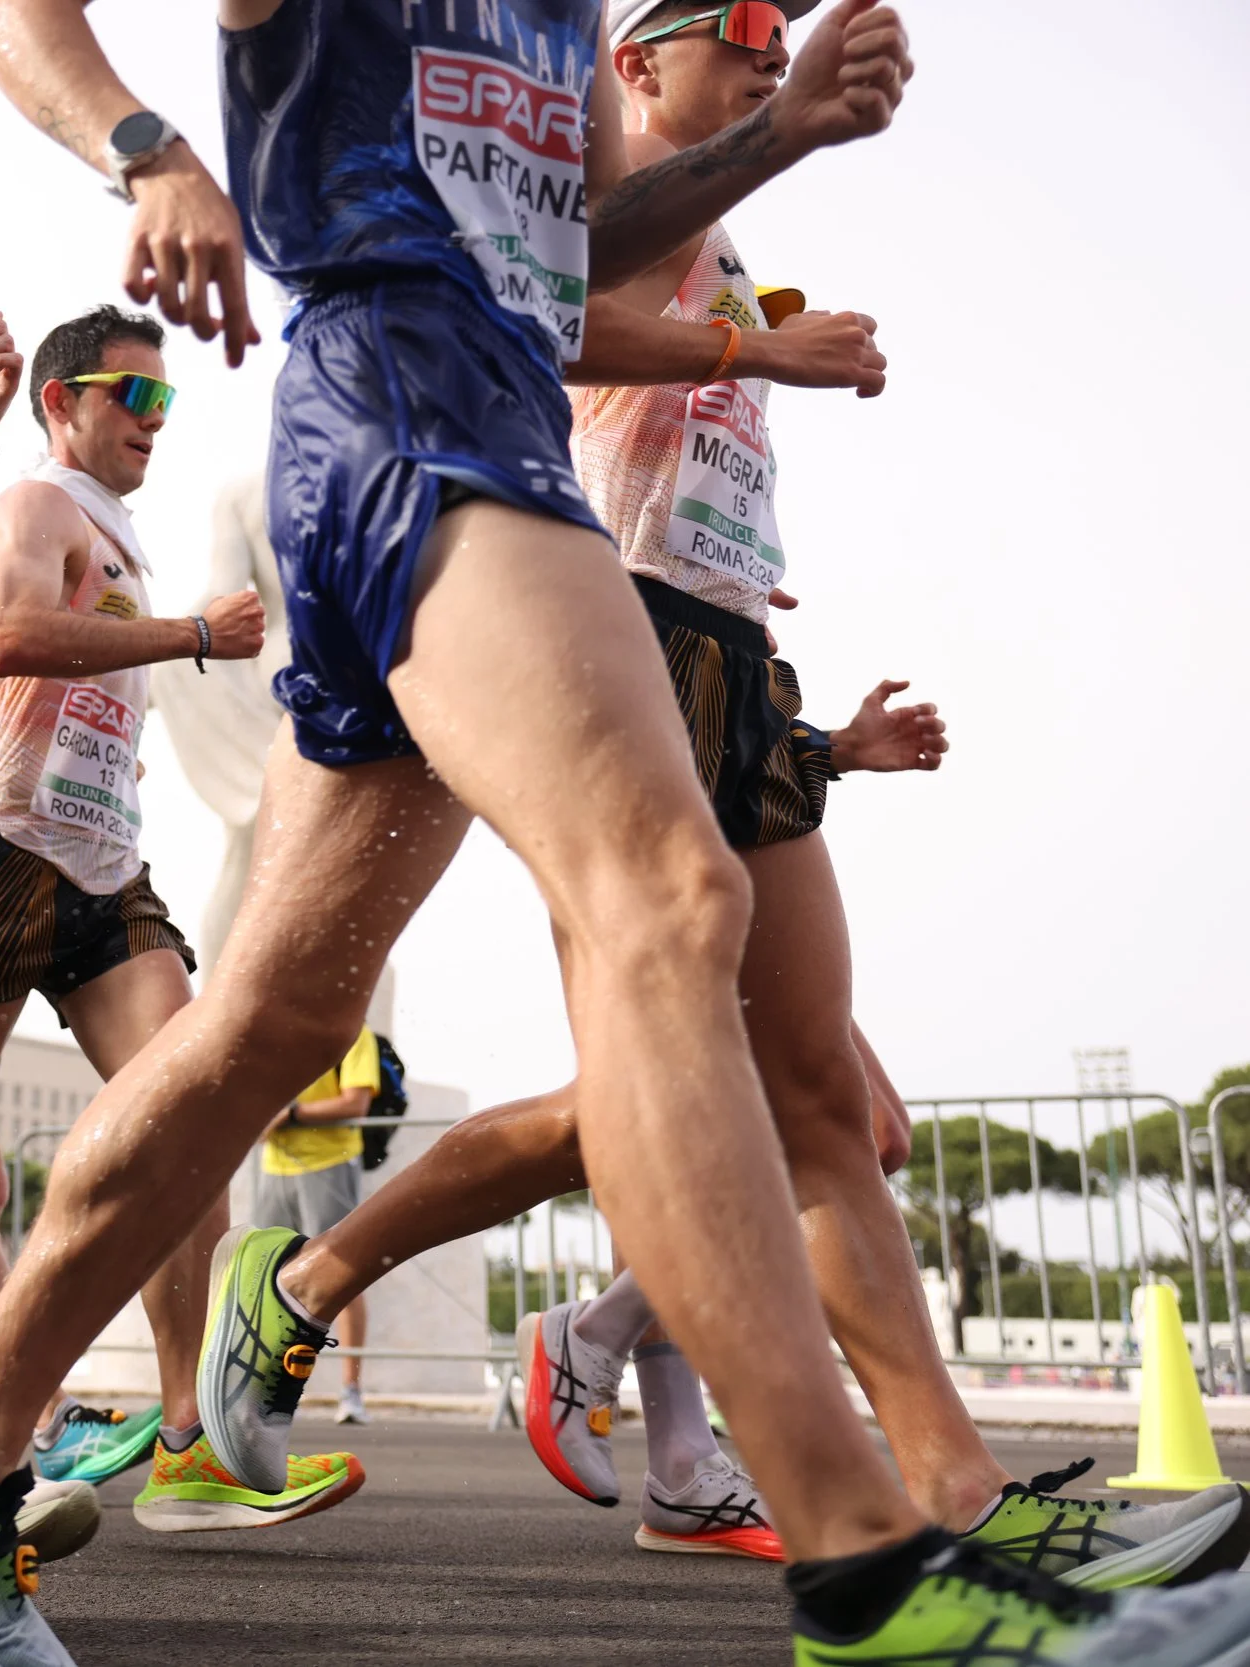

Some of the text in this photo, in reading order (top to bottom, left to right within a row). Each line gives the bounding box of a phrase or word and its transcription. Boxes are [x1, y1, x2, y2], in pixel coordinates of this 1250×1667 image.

[424, 65, 582, 154] SPAR
[422, 132, 588, 226] PARTANE
[697, 385, 766, 445] SPAR
[733, 492, 748, 517] 15
[712, 512, 734, 537] RUN
[691, 531, 775, 588] ROMA 2024
[68, 690, 134, 737] SPAR
[69, 782, 100, 802] RUN
[99, 768, 116, 788] 13
[50, 797, 106, 829] ROMA
